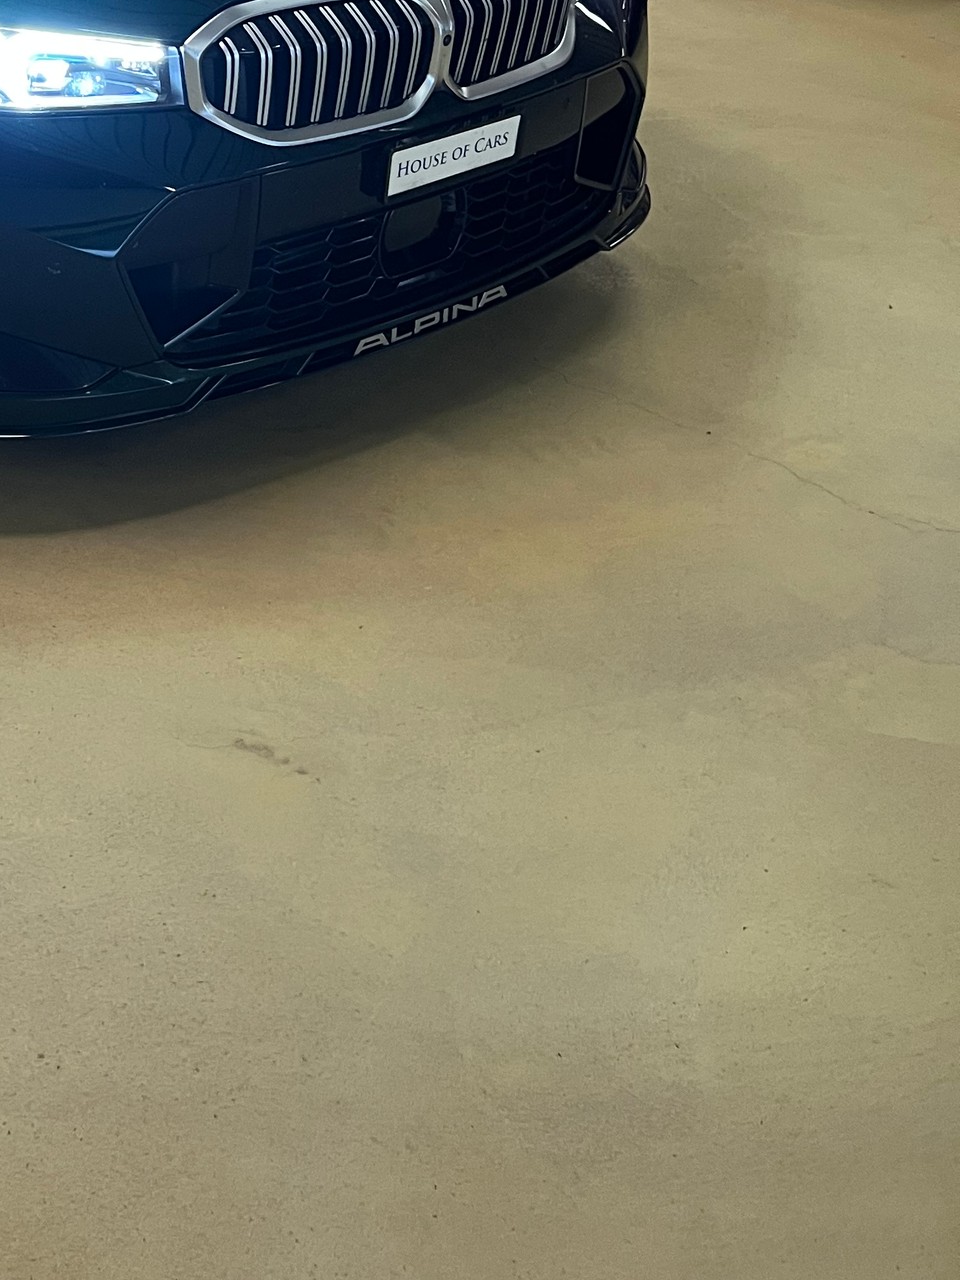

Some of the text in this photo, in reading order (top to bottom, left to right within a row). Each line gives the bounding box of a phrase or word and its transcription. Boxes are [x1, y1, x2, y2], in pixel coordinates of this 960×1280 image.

[397, 131, 509, 178] HOUSE OF CARS
[353, 284, 508, 357] ALPINA
